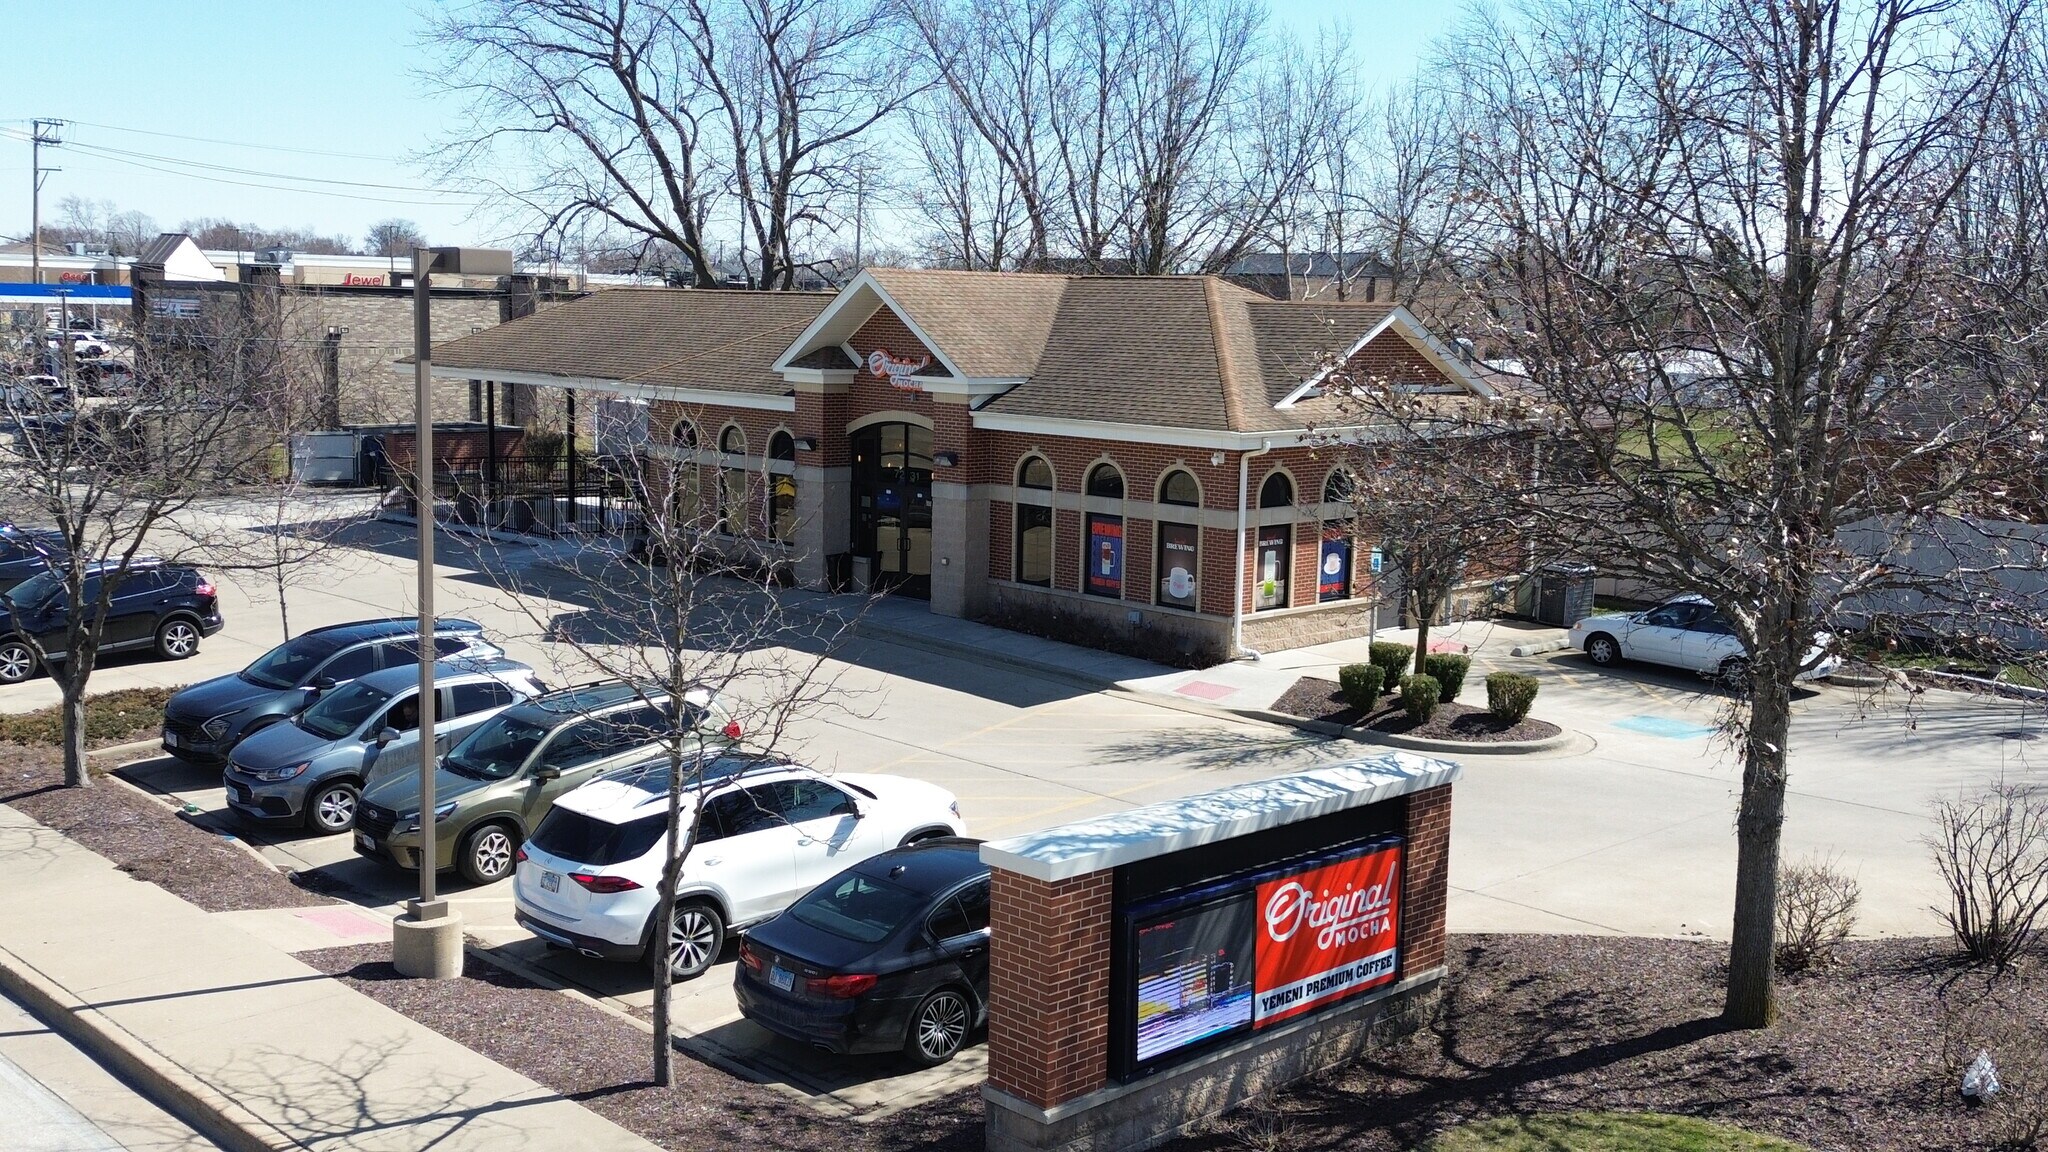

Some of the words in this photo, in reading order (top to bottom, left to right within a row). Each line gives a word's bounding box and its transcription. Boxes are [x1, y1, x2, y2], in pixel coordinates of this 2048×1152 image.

[343, 272, 385, 287] Jewel
[1166, 542, 1195, 552] BREWING
[1265, 860, 1397, 950] Original
[1335, 916, 1391, 948] MOCHA
[1262, 986, 1304, 1012] YEMENI
[1306, 967, 1353, 997] PREMIUM
[1356, 954, 1393, 979] COFFEE
